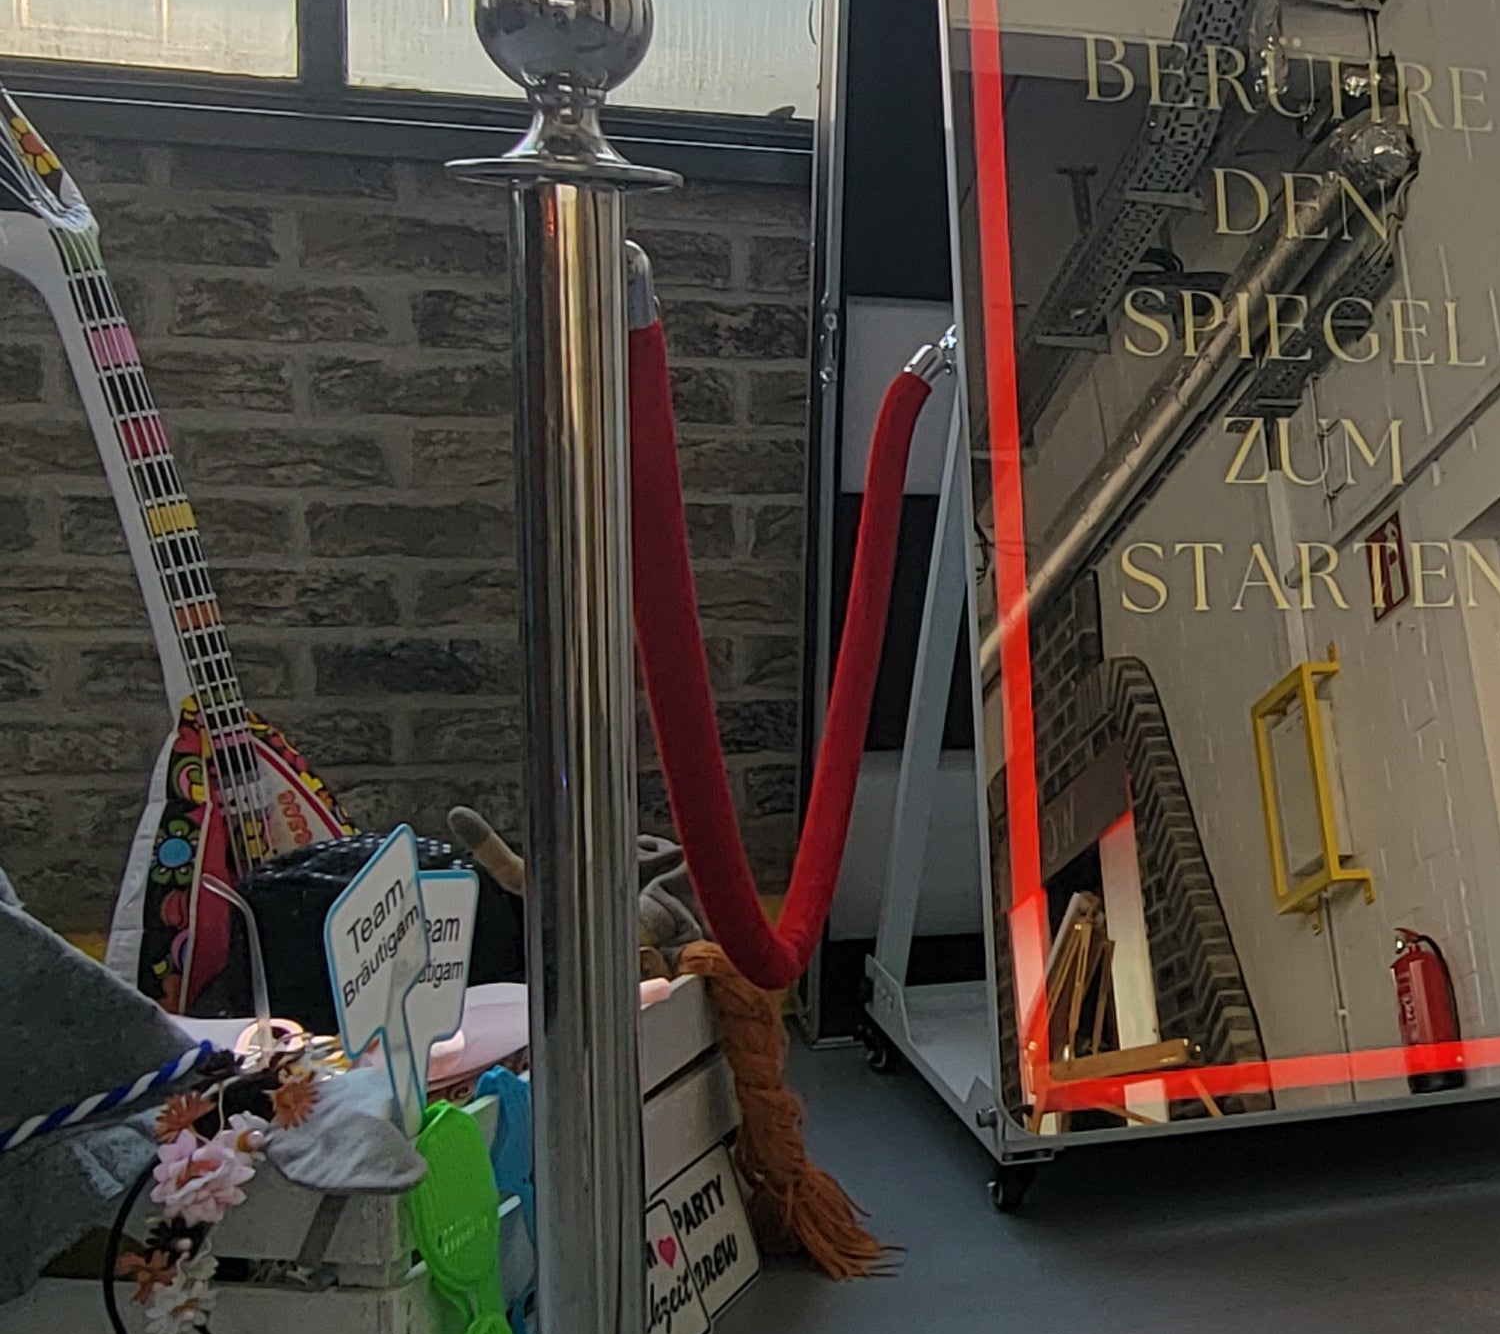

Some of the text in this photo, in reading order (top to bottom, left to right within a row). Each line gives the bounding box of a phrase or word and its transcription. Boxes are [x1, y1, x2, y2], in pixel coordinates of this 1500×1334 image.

[1083, 33, 1494, 132] BERÜHRE
[1213, 168, 1389, 242] DEN
[1122, 288, 1486, 366] SPIEGEL
[1224, 417, 1404, 485] ZUM
[346, 879, 405, 954] Team
[425, 917, 461, 942] eam
[342, 905, 420, 1008] Bräutigam
[418, 957, 464, 989] utigam
